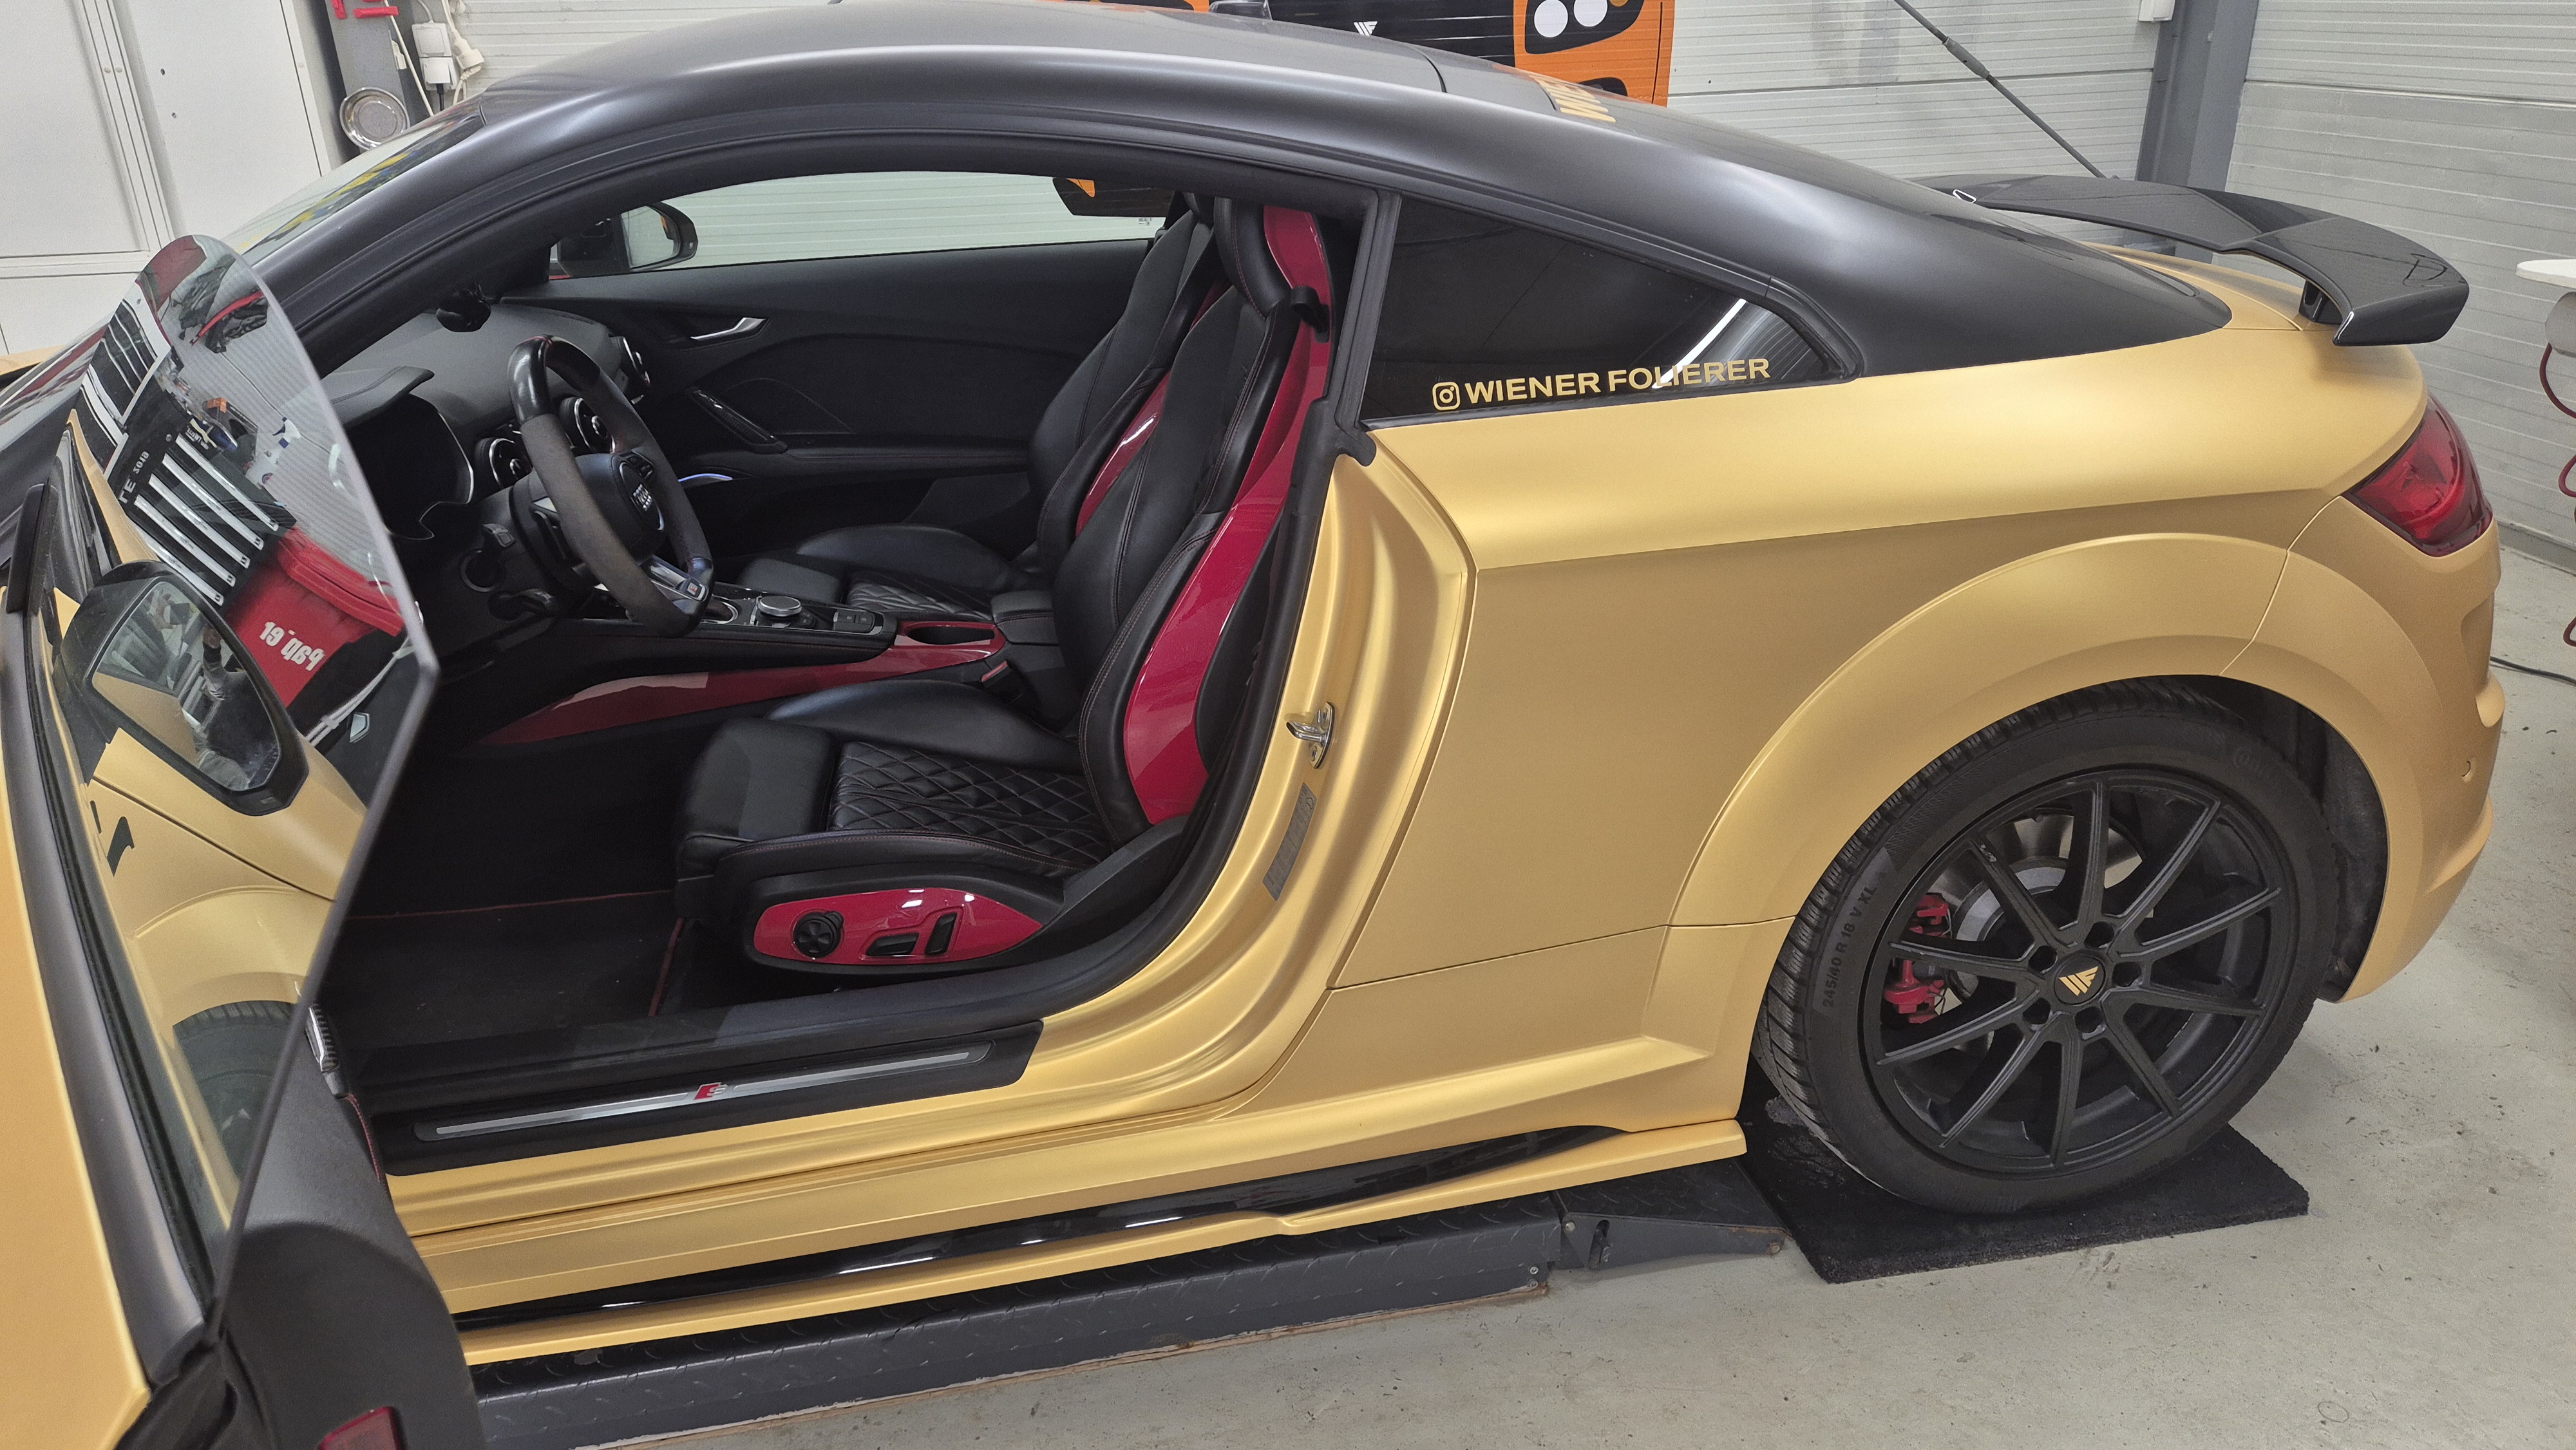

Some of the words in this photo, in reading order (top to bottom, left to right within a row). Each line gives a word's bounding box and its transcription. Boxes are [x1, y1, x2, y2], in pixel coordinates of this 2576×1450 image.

[1464, 372, 1602, 404] WIENER
[1608, 358, 1771, 391] FOLIERER
[1858, 887, 1877, 905] XL
[1850, 906, 1862, 917] V
[1841, 922, 1855, 937] 18
[1835, 942, 1848, 953] R
[1822, 957, 1842, 1008] 245/40
